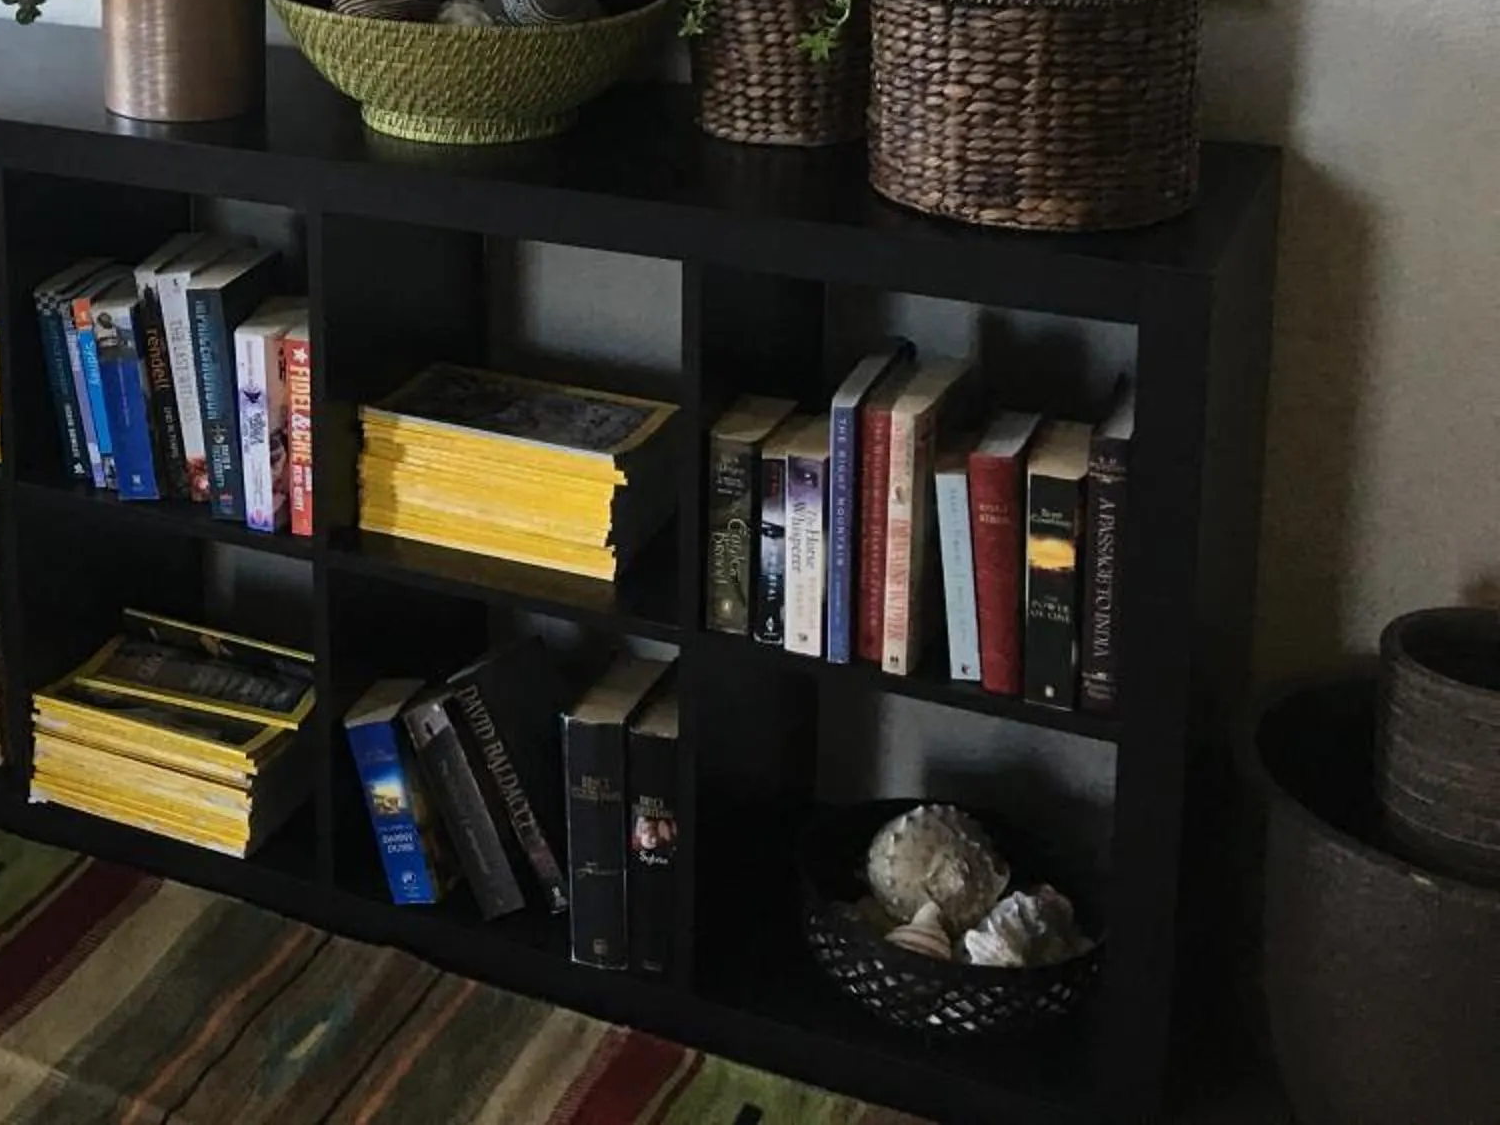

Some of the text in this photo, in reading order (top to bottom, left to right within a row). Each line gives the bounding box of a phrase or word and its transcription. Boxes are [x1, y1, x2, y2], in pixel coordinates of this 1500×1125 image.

[84, 341, 100, 385] Sydney
[147, 328, 171, 390] rendell
[290, 364, 310, 413] FIDEL
[292, 431, 312, 466] CHE
[838, 418, 847, 443] THE
[838, 451, 847, 490] RIGHT
[1099, 497, 1116, 510] A
[788, 502, 805, 572] Whisperer
[805, 529, 820, 569] Horse
[836, 497, 845, 566] MOUNTAIN
[1097, 514, 1116, 583] PASSAGE
[1093, 612, 1111, 656] INDIA
[455, 684, 537, 828] DAVID BALDACCI
